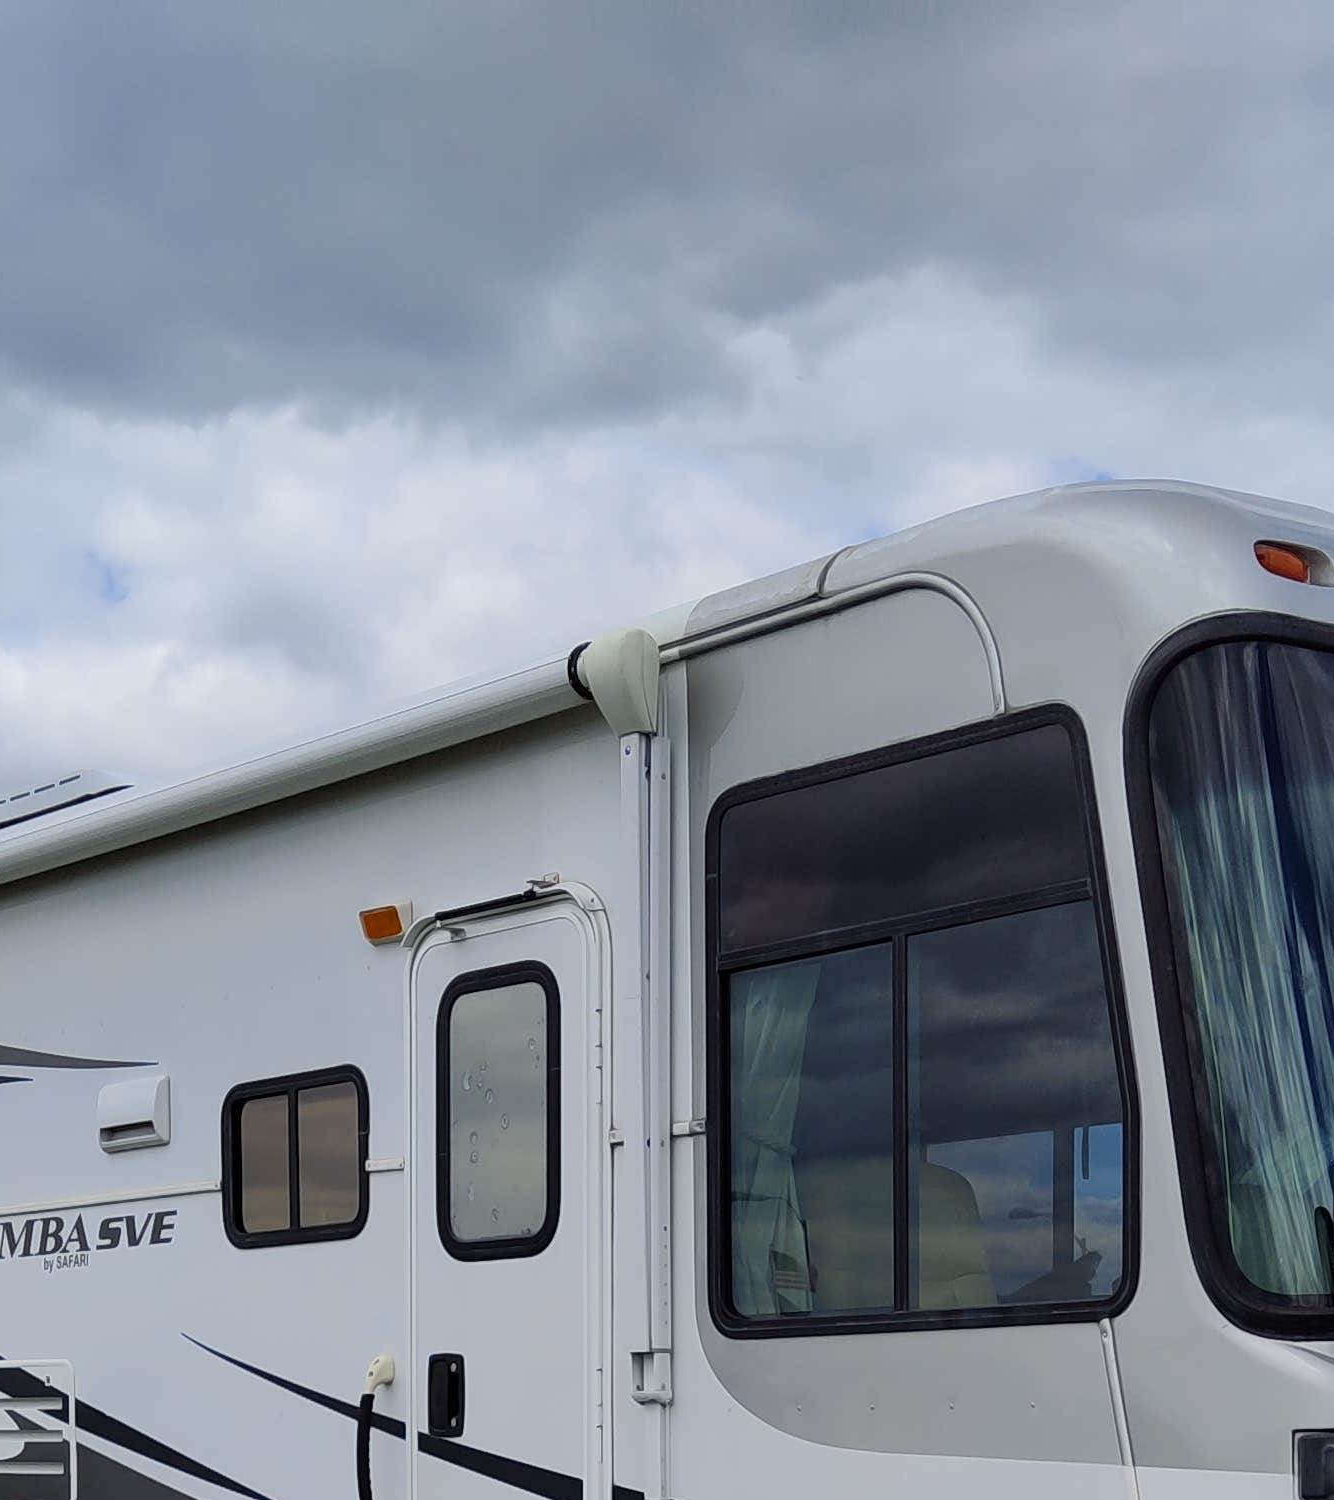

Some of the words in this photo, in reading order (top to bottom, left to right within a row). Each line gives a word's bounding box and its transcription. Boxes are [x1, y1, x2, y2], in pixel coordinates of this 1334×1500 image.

[96, 1210, 177, 1250] SVE
[43, 1256, 54, 1273] by
[56, 1253, 89, 1270] SAFARI
